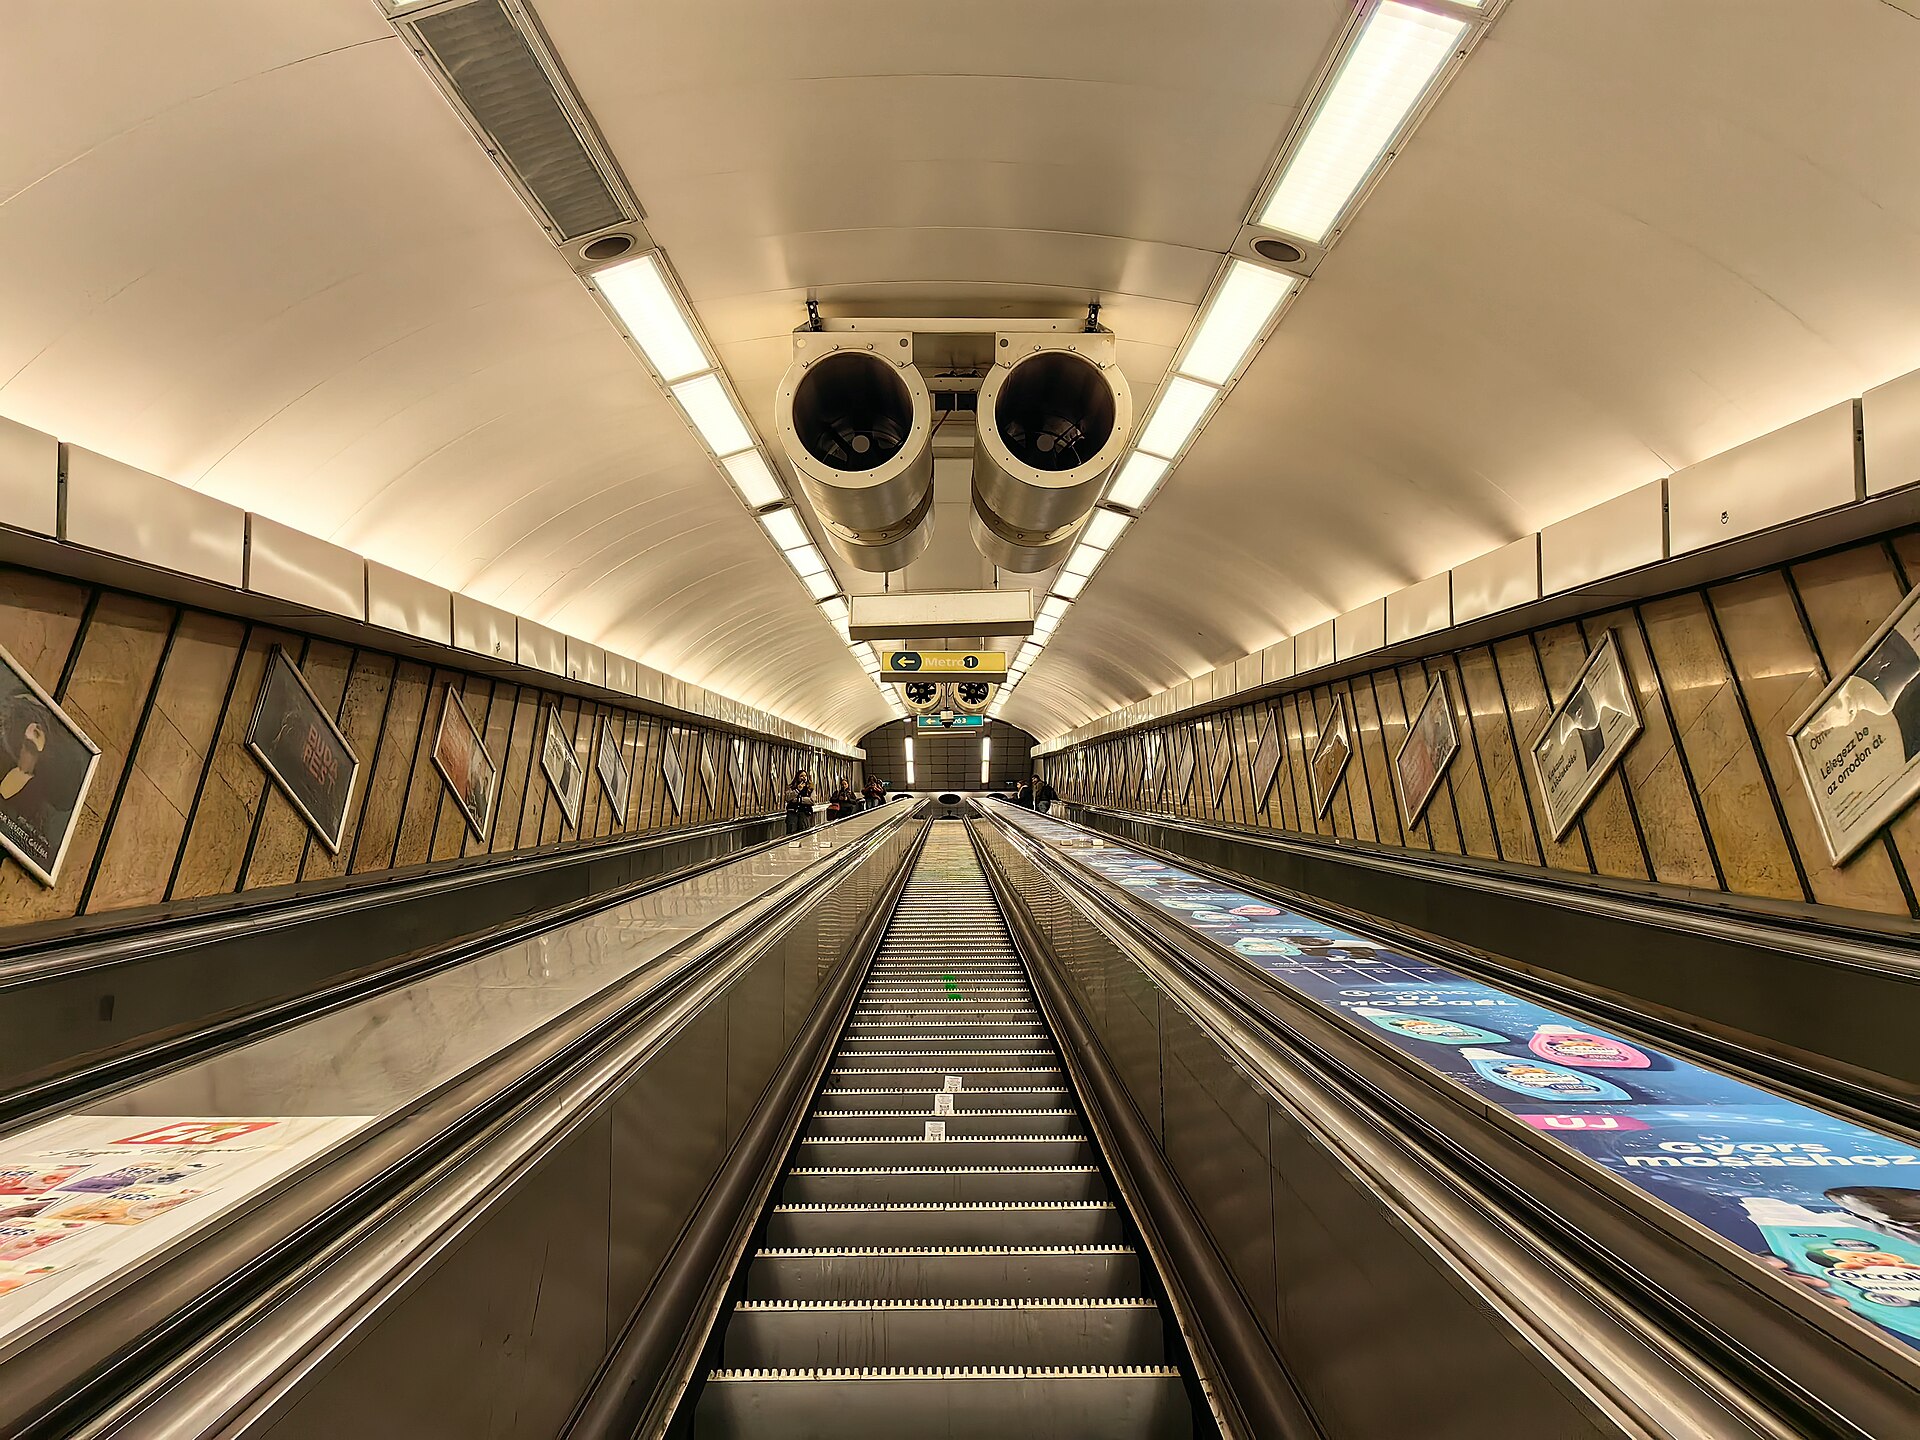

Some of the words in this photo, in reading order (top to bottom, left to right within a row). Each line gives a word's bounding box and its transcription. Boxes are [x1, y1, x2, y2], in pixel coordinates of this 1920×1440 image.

[1855, 727, 1869, 742] be
[308, 724, 338, 779] BUDA
[1827, 781, 1838, 796] az
[1837, 747, 1872, 784] orrodon
[1543, 1114, 1619, 1129] ÚJ
[1658, 1141, 1832, 1156] Gyors
[1623, 1153, 1920, 1167] mosáshoz
